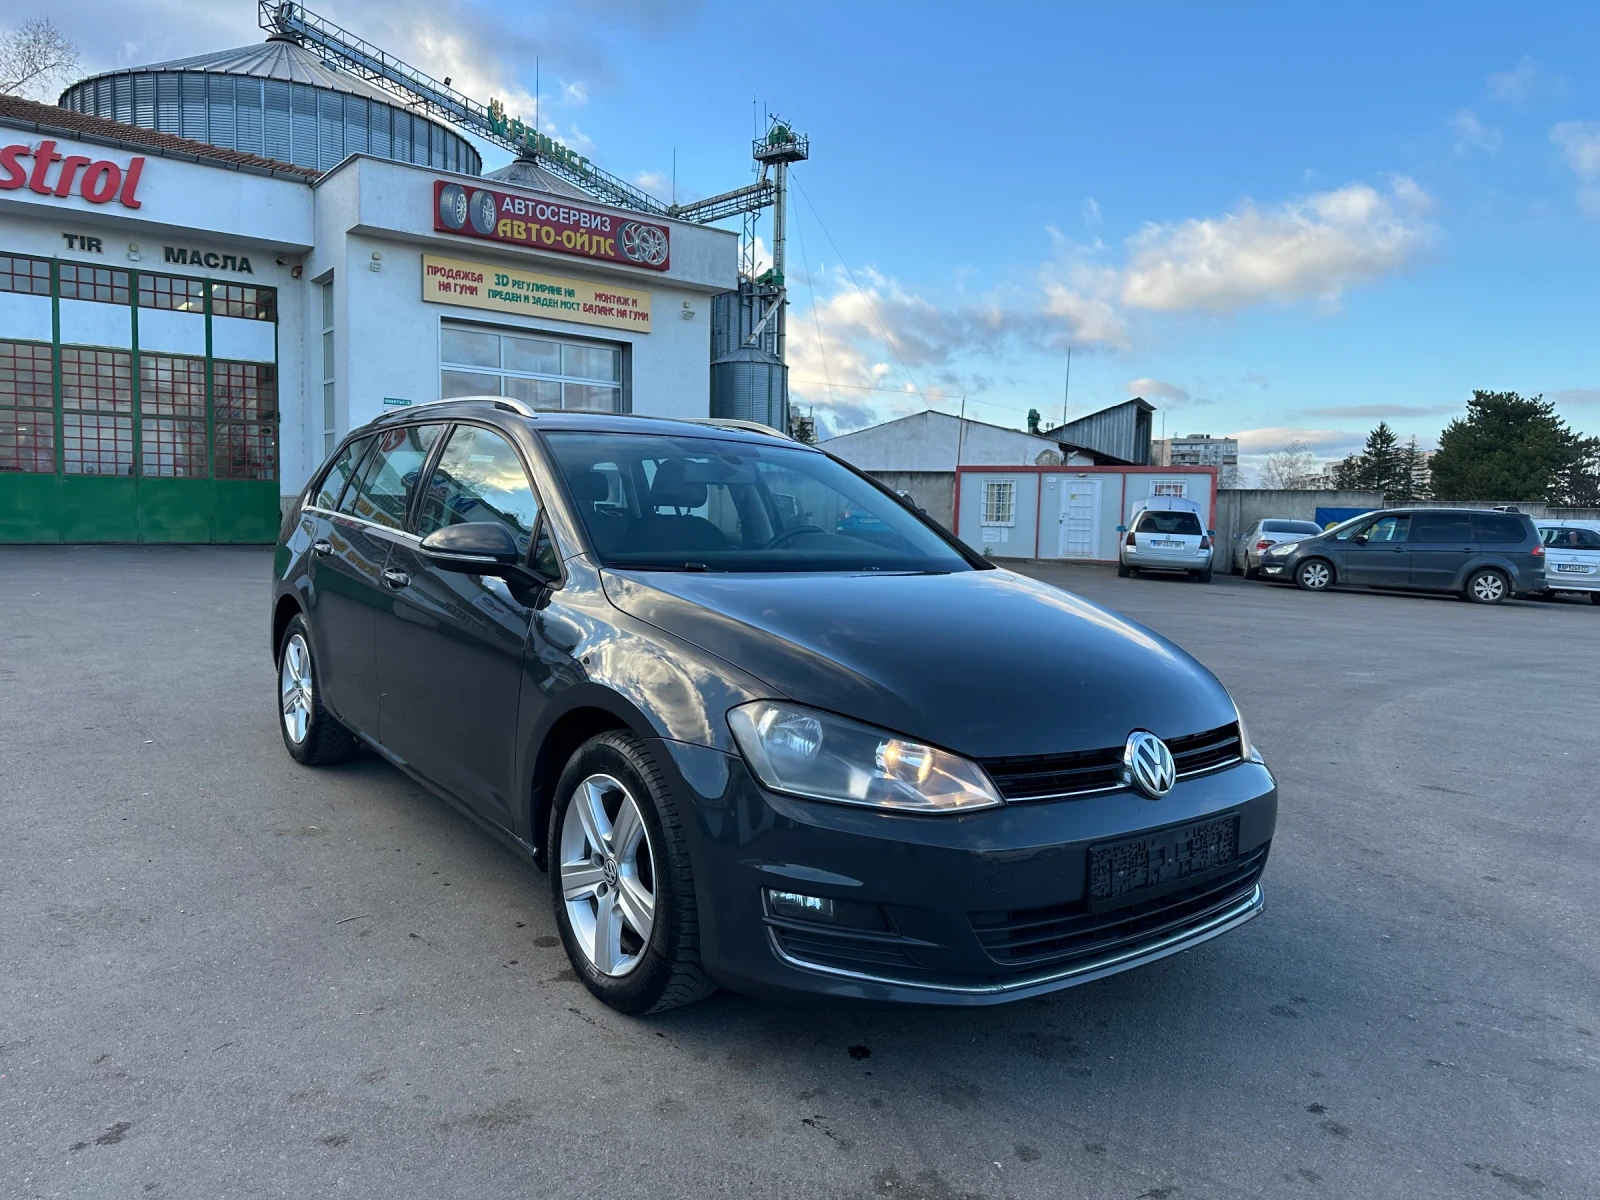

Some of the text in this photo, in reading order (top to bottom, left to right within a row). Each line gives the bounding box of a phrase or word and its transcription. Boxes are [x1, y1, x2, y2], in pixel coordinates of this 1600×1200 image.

[0, 140, 146, 208] strol
[501, 196, 611, 232] АВТОСЕРВИЗ
[62, 233, 103, 253] TIR
[497, 218, 615, 257] АВТО-ОЙЛС
[163, 245, 254, 275] МАСЛА
[426, 264, 484, 283] ПРОДАЖБА
[438, 280, 478, 296] НА ГУМИ
[494, 273, 575, 298] 3D РЕГУЛИРАНЕ НА
[487, 288, 581, 311] ПРЕДЕН И ЗАДЕН МОСТ
[594, 291, 638, 308] МОНТАЖ И
[582, 302, 649, 321] БАЛАНС НА ГУМИ
